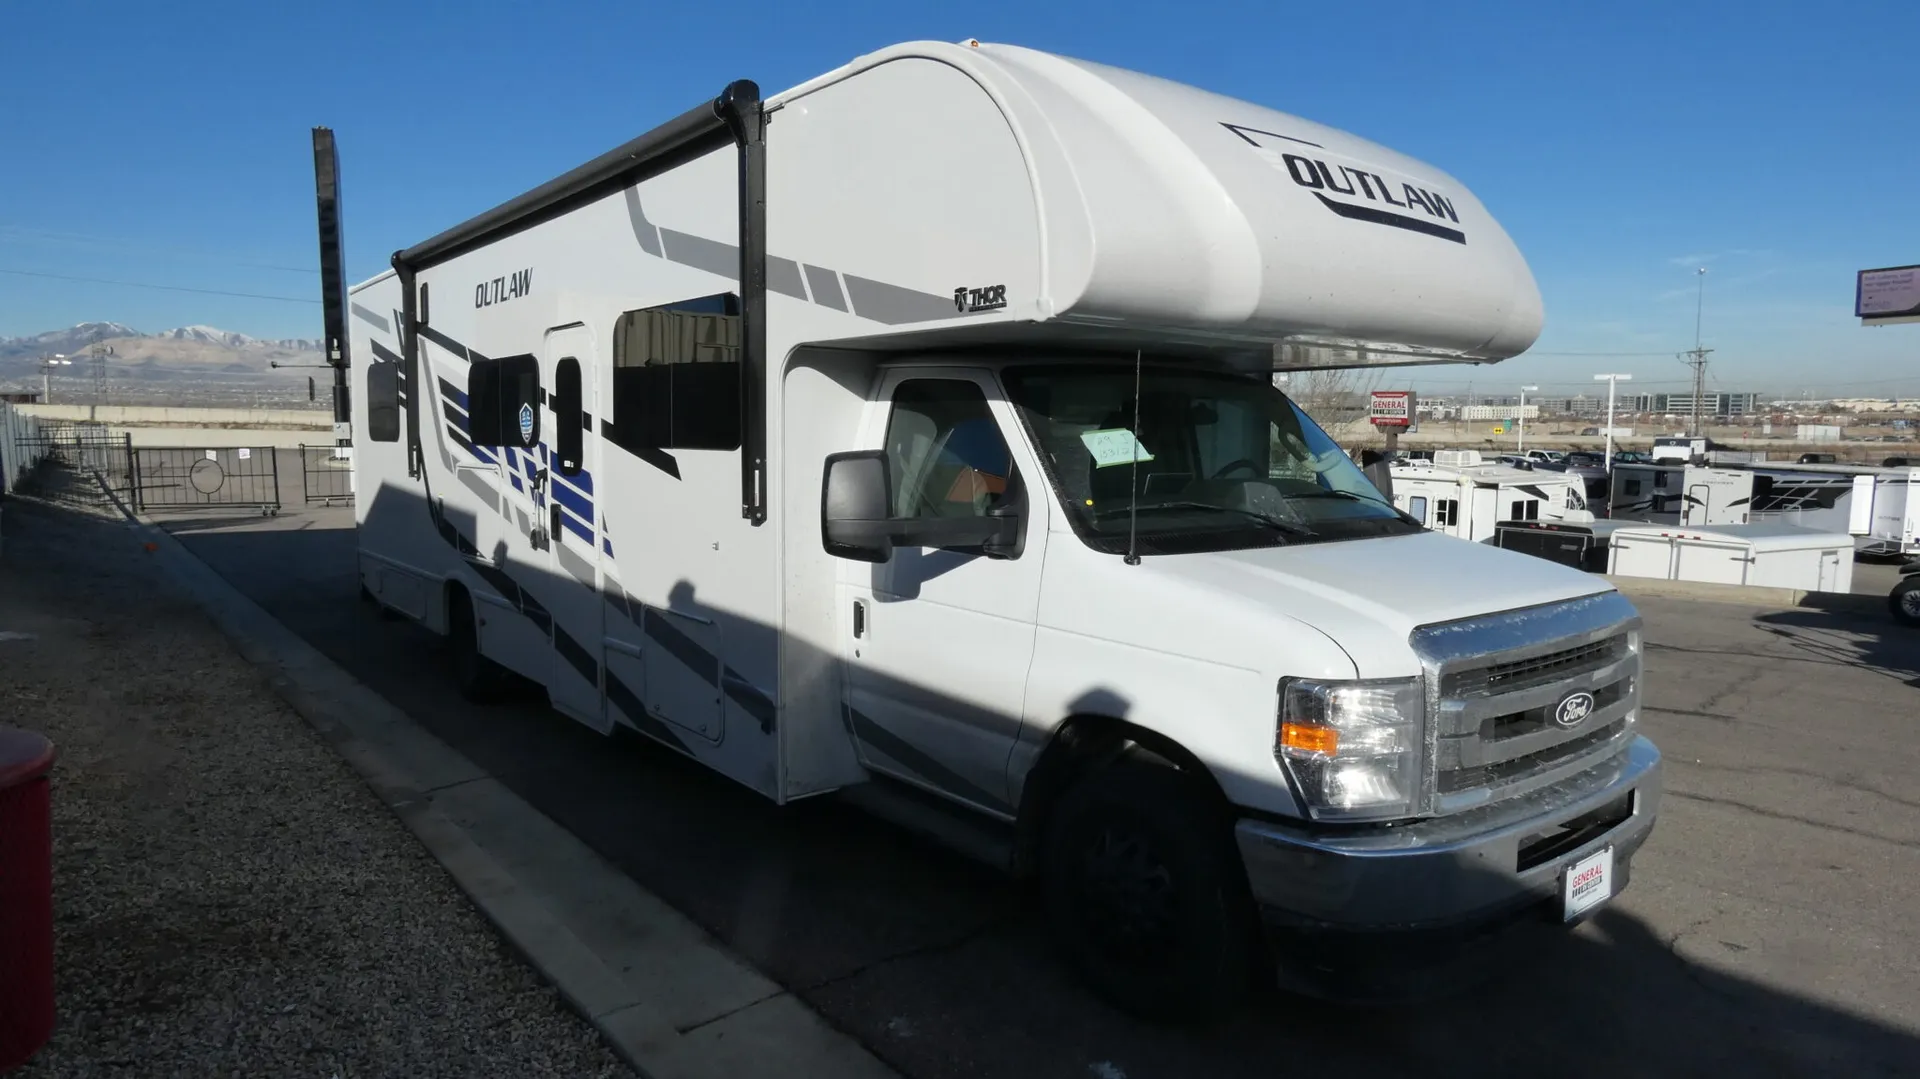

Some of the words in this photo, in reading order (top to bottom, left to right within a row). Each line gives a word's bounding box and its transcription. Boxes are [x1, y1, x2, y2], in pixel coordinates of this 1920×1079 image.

[1282, 153, 1460, 224] OUTLAW
[475, 267, 533, 308] OUTLAW
[968, 284, 1007, 307] THOR
[1563, 697, 1588, 722] Ford
[1572, 863, 1603, 888] GENERAL
